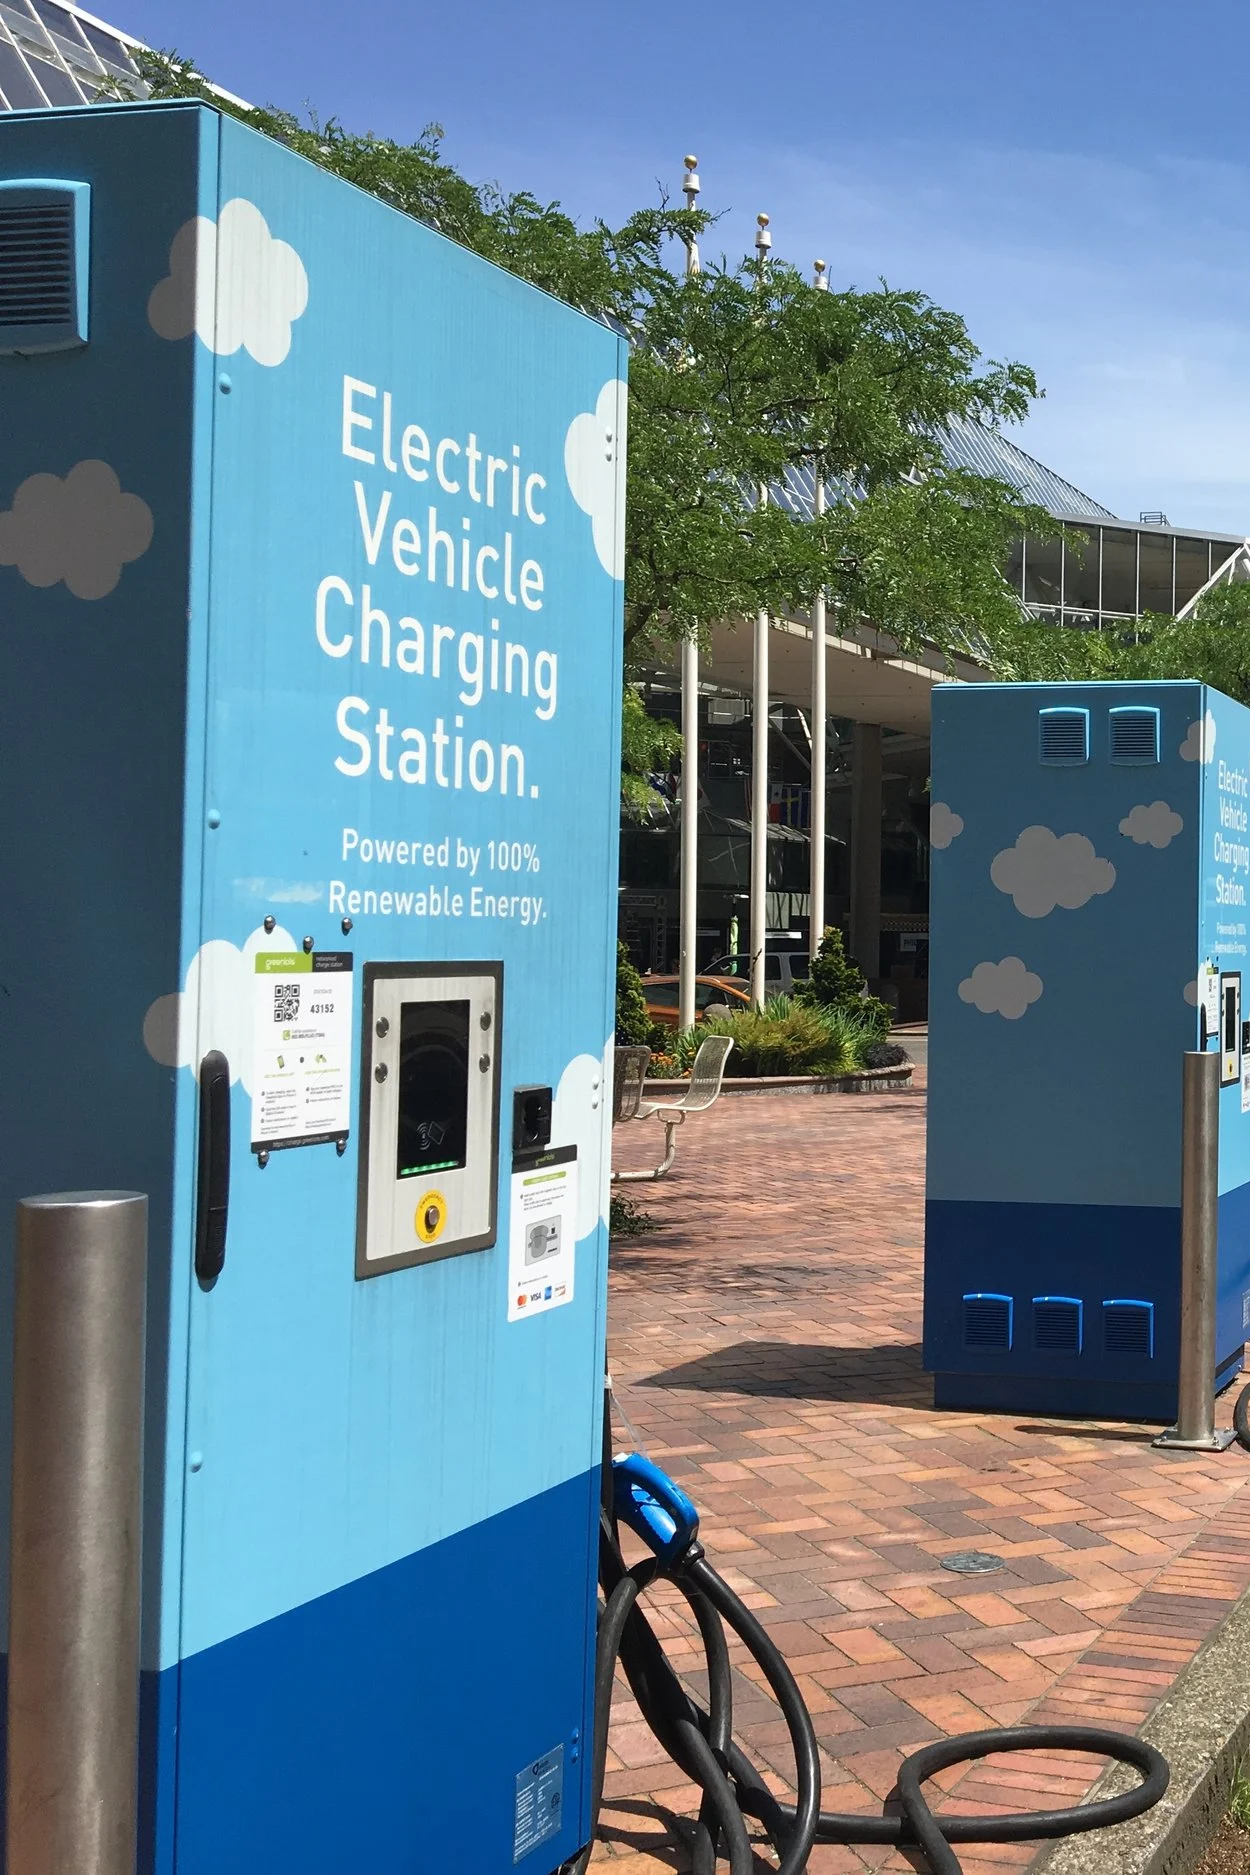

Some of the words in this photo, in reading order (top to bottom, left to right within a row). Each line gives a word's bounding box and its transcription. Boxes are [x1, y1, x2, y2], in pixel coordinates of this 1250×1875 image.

[342, 374, 547, 525] Electric
[353, 481, 545, 611] Vehicle
[315, 575, 558, 721] Charging
[334, 695, 539, 799] Station.
[1218, 759, 1248, 798] Electric
[1219, 796, 1248, 833] Vehicle
[342, 828, 449, 867] Powered
[457, 836, 481, 876] by
[488, 841, 540, 873] 100%
[1214, 831, 1249, 875] Charging
[329, 881, 462, 917] Renewable
[470, 887, 547, 926] Energy.
[1215, 873, 1246, 906] Station.
[310, 1003, 334, 1014] 43152
[530, 1291, 542, 1302] VISA
